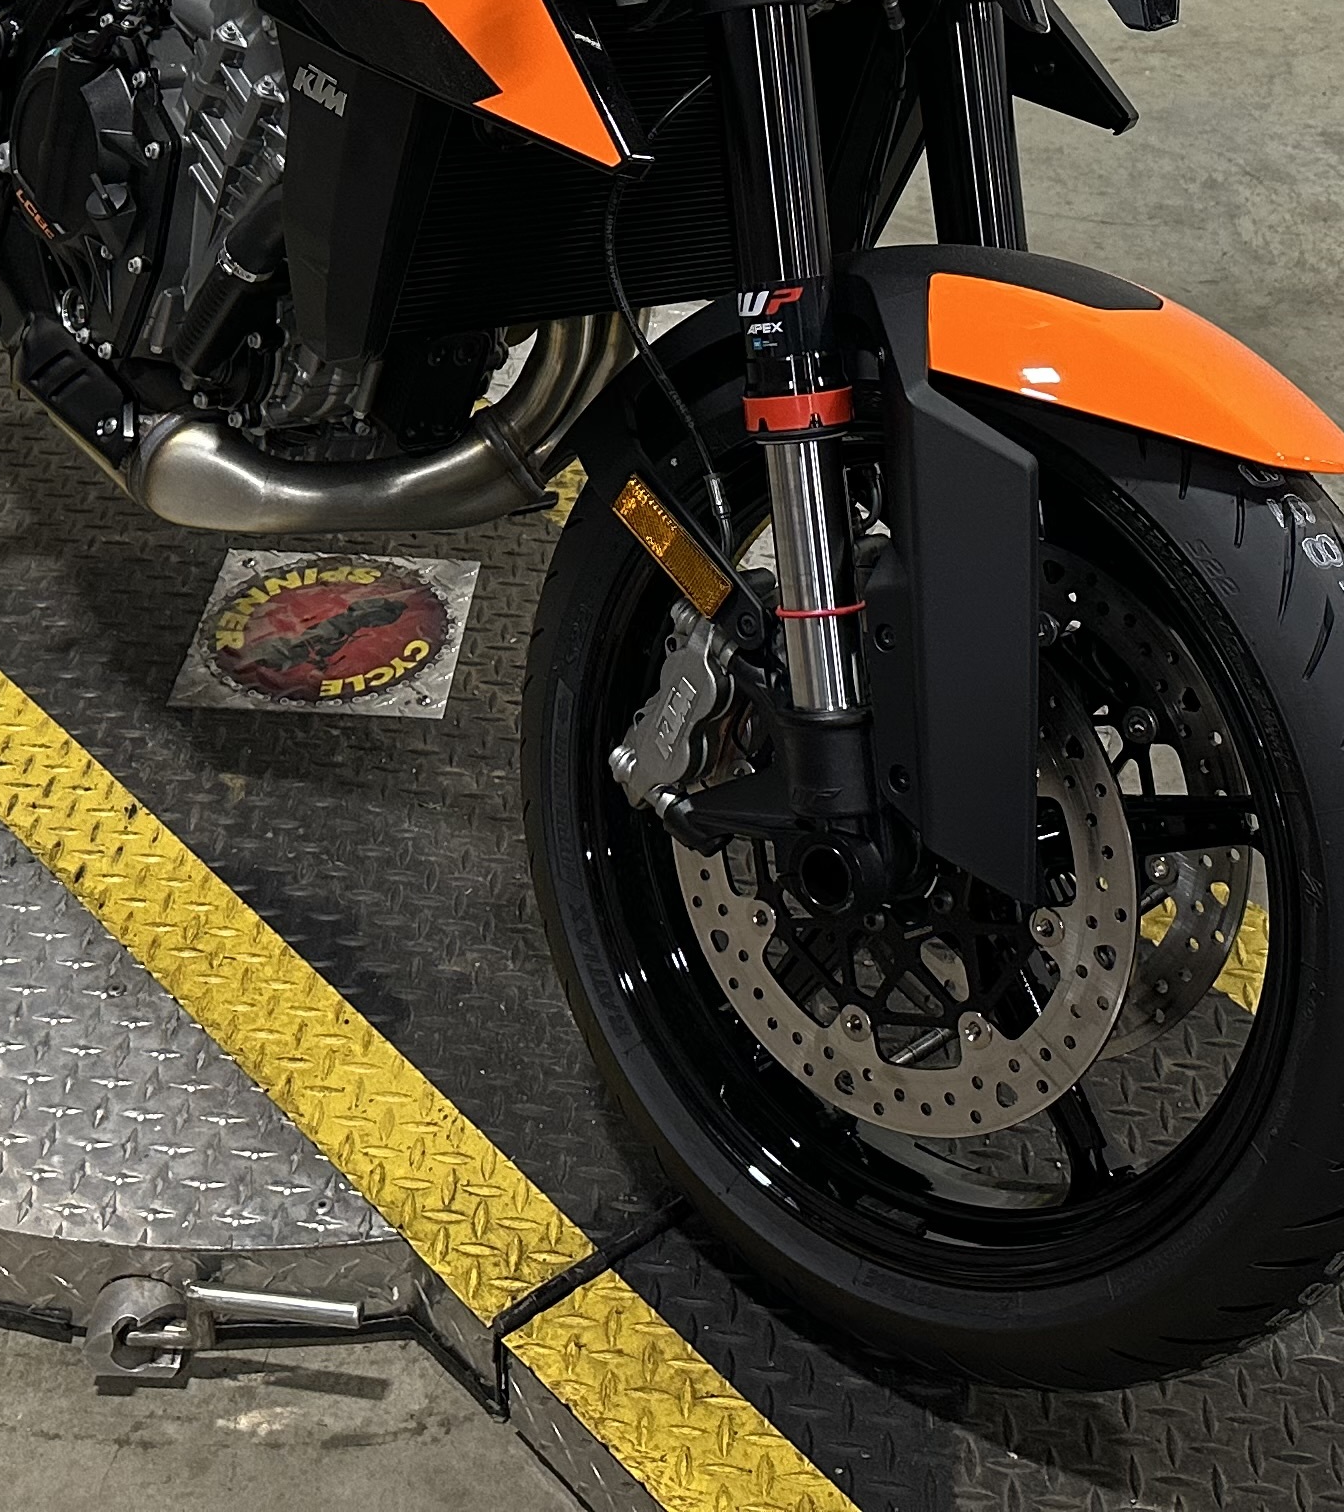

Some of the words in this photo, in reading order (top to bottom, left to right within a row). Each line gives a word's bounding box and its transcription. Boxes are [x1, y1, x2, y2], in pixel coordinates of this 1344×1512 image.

[292, 63, 348, 118] KTM
[737, 286, 805, 317] WP
[746, 320, 785, 336] APEX
[215, 566, 383, 651] SPINNER
[319, 638, 431, 698] CYCLE
[654, 676, 697, 761] KTM
